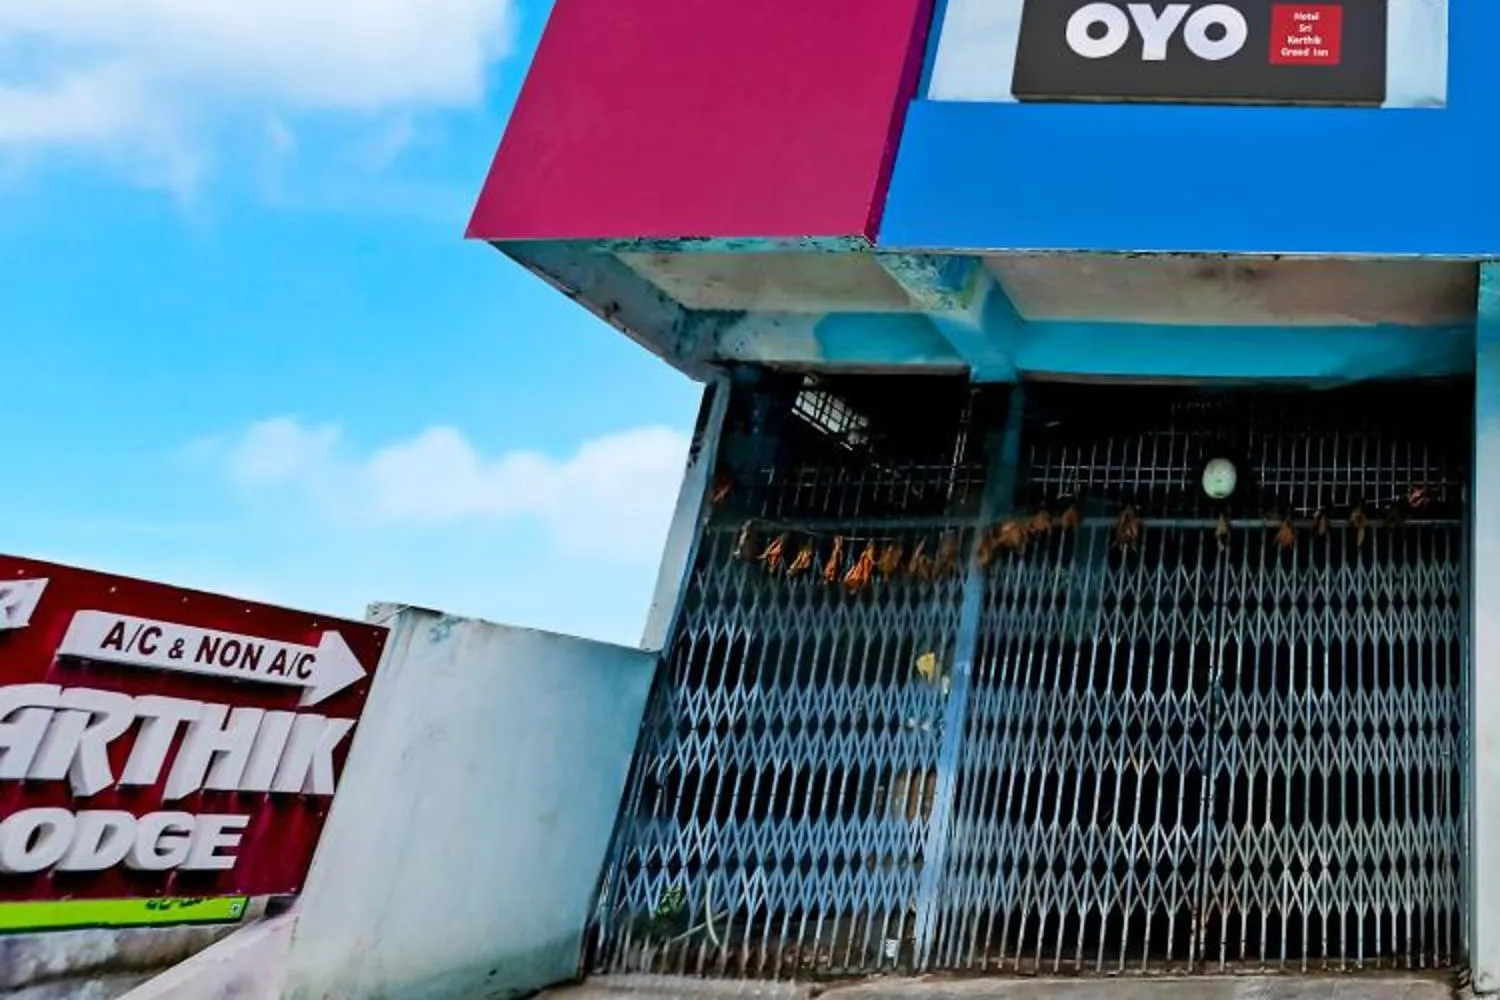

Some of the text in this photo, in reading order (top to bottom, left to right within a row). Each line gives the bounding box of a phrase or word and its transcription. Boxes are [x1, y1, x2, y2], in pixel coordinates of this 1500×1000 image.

[1065, 2, 1248, 61] OYO
[101, 621, 317, 680] A/C & NON A/C
[0, 807, 250, 874] ODGE
